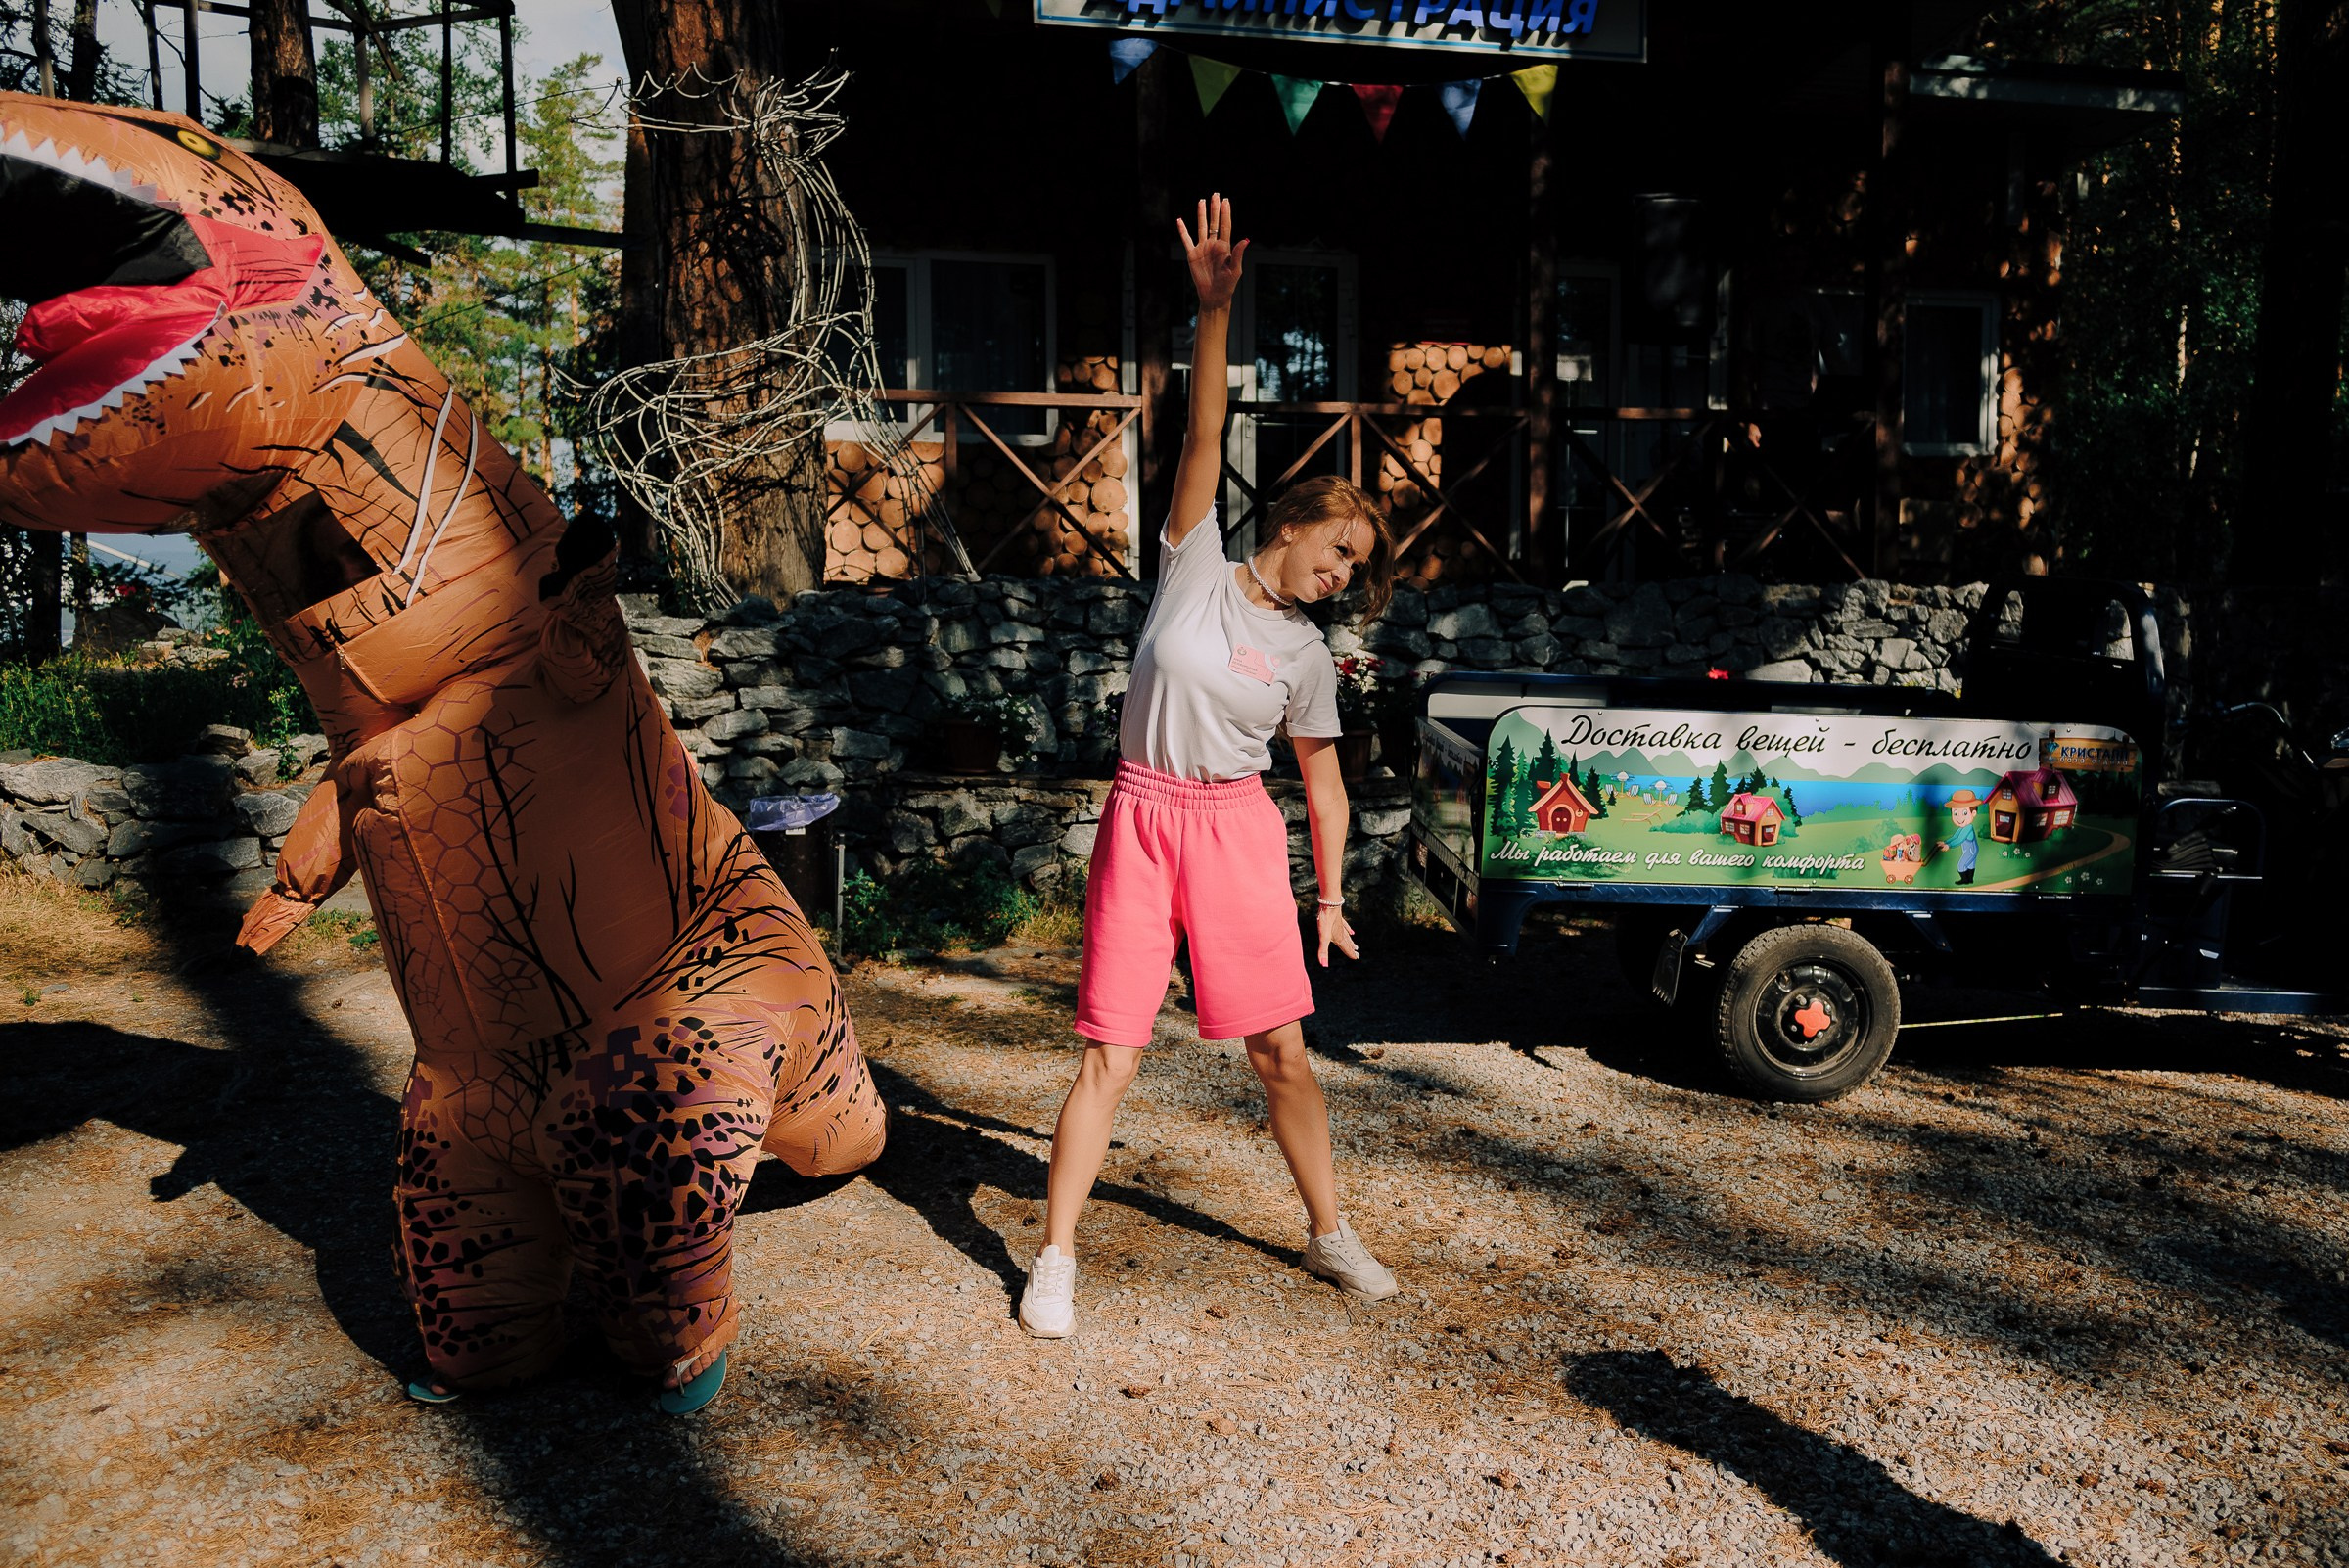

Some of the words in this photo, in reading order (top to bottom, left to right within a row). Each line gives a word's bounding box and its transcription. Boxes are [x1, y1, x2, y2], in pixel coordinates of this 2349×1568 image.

[1110, 0, 1598, 39] СТРАЦИЯ
[1561, 714, 1723, 749] Доставка
[1735, 725, 1830, 757] вещей
[1872, 728, 2032, 760] бесплатно
[2061, 747, 2129, 761] КРИСТАЛЛ
[1490, 841, 1530, 860] Мы
[1534, 844, 1637, 867] работаем
[1645, 851, 1681, 870] для
[1688, 849, 1756, 867] вашего
[1762, 853, 1865, 874] комфорта
